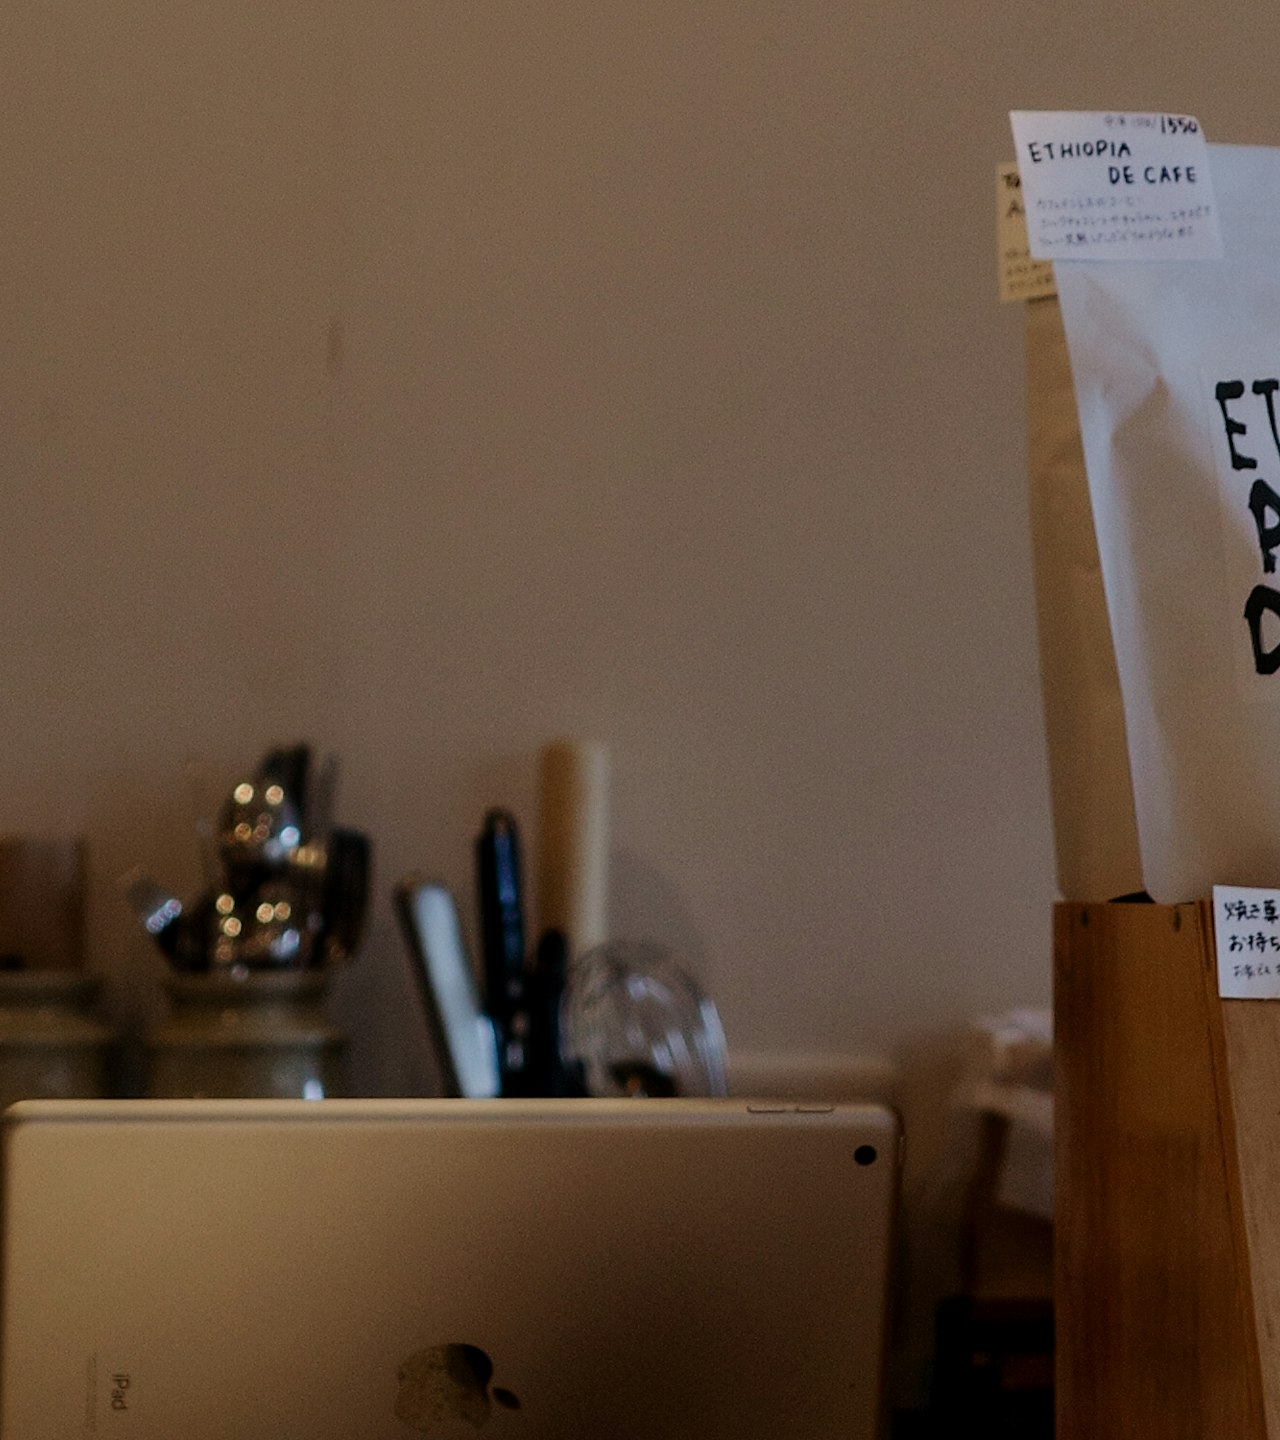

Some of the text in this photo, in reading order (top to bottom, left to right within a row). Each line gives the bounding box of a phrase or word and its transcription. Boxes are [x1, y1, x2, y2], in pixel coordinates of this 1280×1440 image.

[1028, 140, 1131, 162] ETHIOPIA
[1109, 166, 1197, 184] DE CAFE
[111, 1374, 131, 1410] iPad
